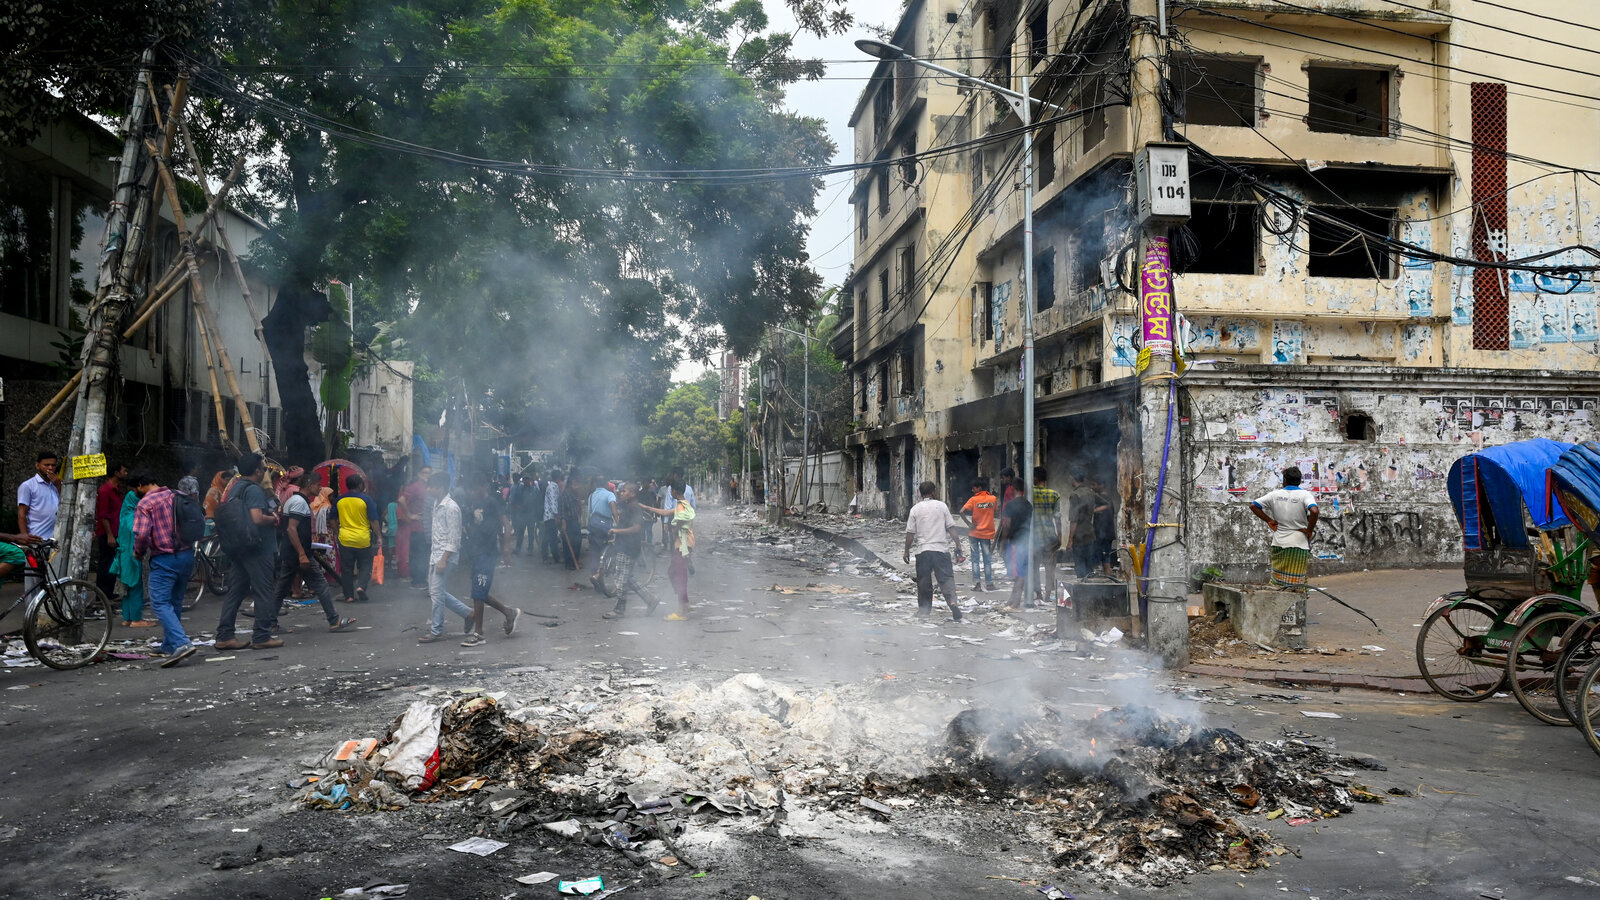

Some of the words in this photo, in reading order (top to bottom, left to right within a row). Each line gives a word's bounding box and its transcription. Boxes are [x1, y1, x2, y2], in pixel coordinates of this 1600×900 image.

[1161, 164, 1177, 178] DB
[1157, 185, 1185, 199] 104
[1144, 260, 1171, 338] উন্মেষ
